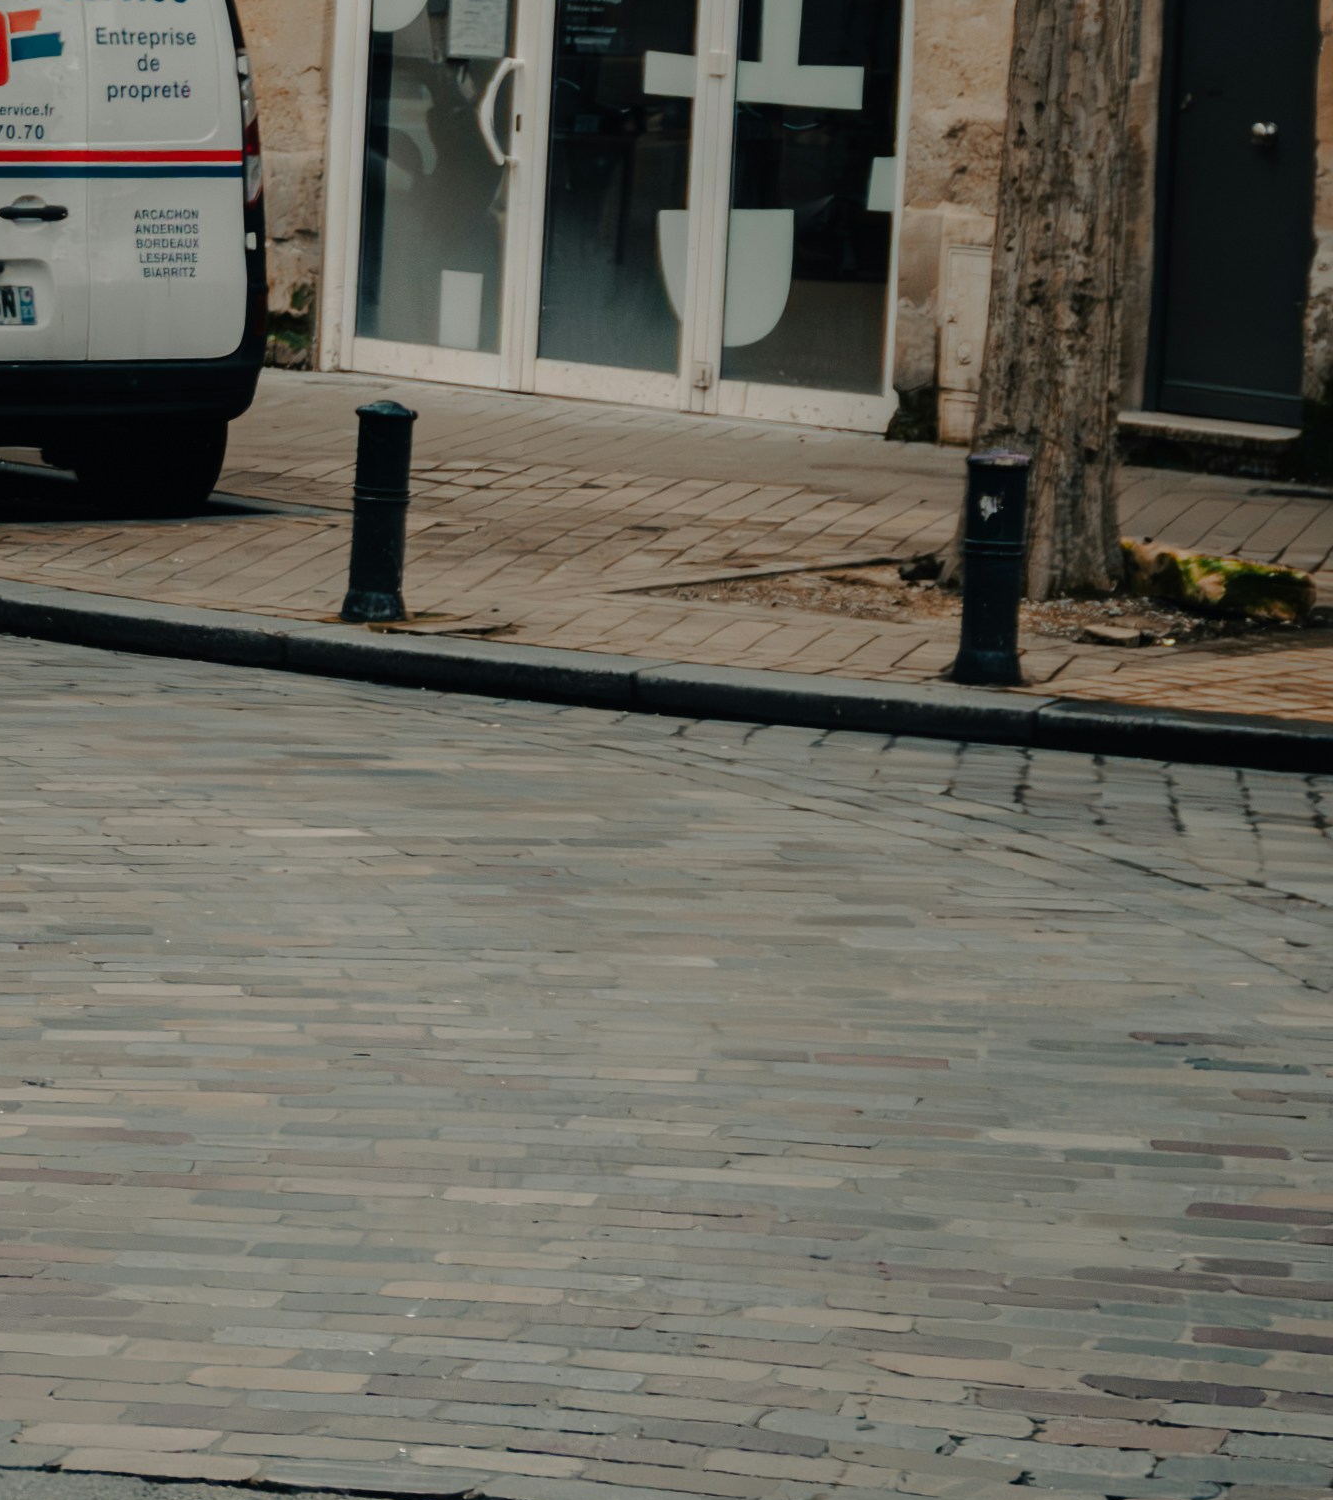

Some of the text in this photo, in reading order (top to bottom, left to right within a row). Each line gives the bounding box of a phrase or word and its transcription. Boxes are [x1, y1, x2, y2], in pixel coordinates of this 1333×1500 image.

[95, 27, 197, 50] Entreprise
[137, 54, 160, 72] de
[107, 81, 191, 102] propreté
[134, 209, 199, 220] ARCACHON
[135, 224, 199, 234] ANDERNOS
[135, 238, 200, 249] BORDEAUX
[139, 253, 198, 264] LESPARRE
[143, 267, 196, 278] BIARRITZ
